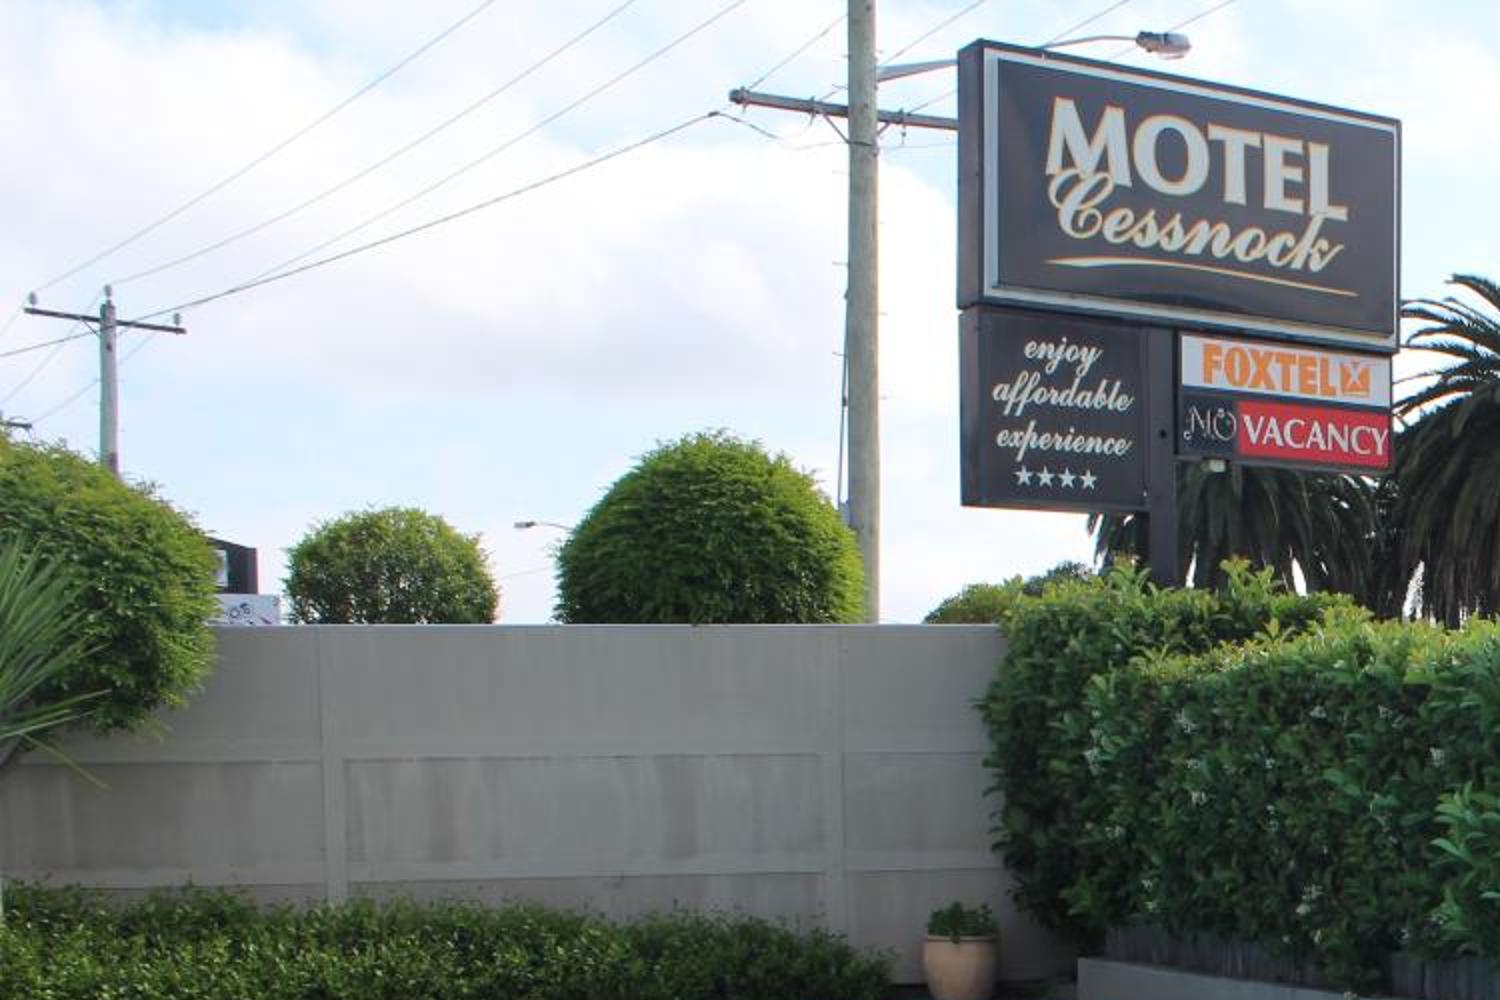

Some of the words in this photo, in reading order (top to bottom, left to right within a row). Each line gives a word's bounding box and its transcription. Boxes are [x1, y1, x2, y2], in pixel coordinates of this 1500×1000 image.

[1046, 96, 1347, 221] MOTEL
[1048, 168, 1344, 272] Cessnock
[1024, 336, 1103, 377] enjoy
[1202, 343, 1336, 396] FOXTEL
[992, 369, 1135, 416] affordable
[997, 420, 1132, 462] experience
[1243, 413, 1389, 456] VACANCY
